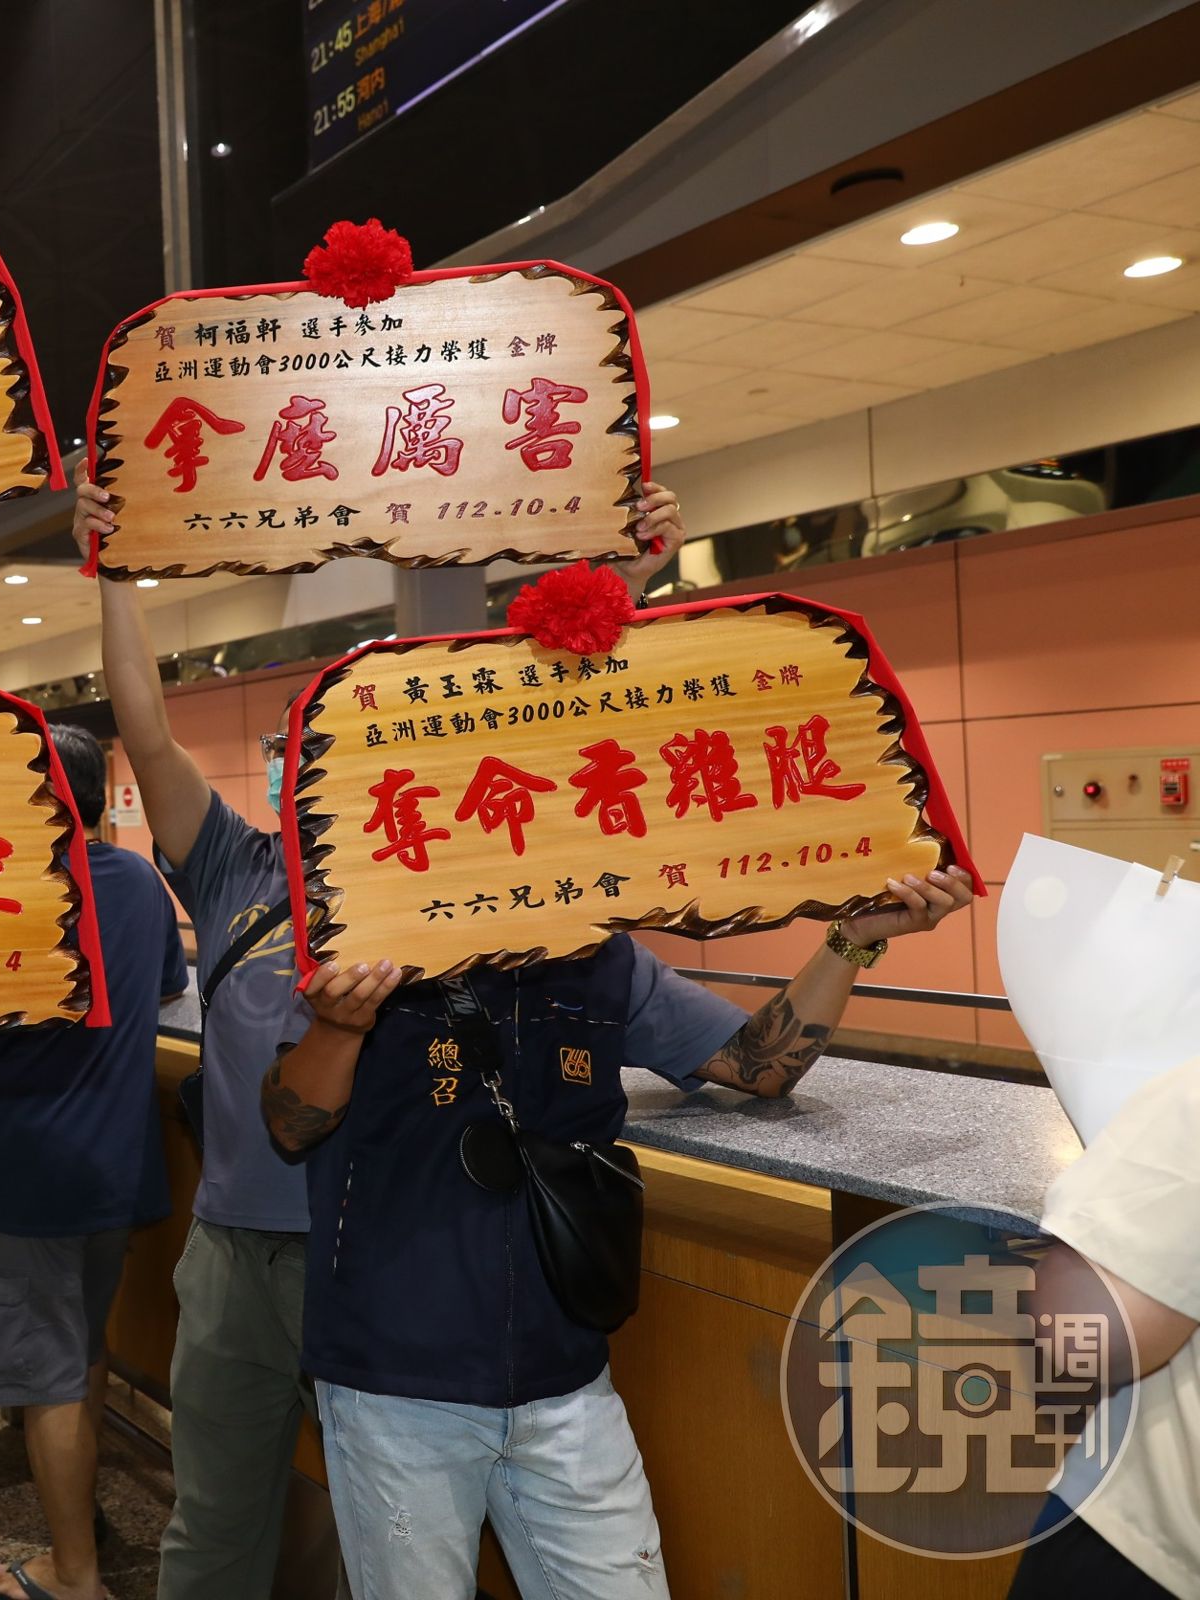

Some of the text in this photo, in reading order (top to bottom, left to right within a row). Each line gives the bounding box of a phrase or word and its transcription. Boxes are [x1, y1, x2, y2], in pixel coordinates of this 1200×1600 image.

[311, 19, 352, 73] 21:45
[313, 85, 355, 136] 21:55
[155, 314, 404, 350] 賀 柯福軒 選手參加
[506, 332, 558, 357] 金牌
[143, 376, 588, 494] 拿麼厲害
[183, 496, 582, 531] 六六兄弟會 賀 112.10.4
[352, 655, 629, 712] 賀 黃玉霖 選手參加
[751, 664, 803, 692] 金牌
[362, 714, 867, 873] 奪命香雞腿
[419, 836, 873, 922] 六六兄弟會 賀 112.10.4
[427, 1038, 463, 1107] 總召
